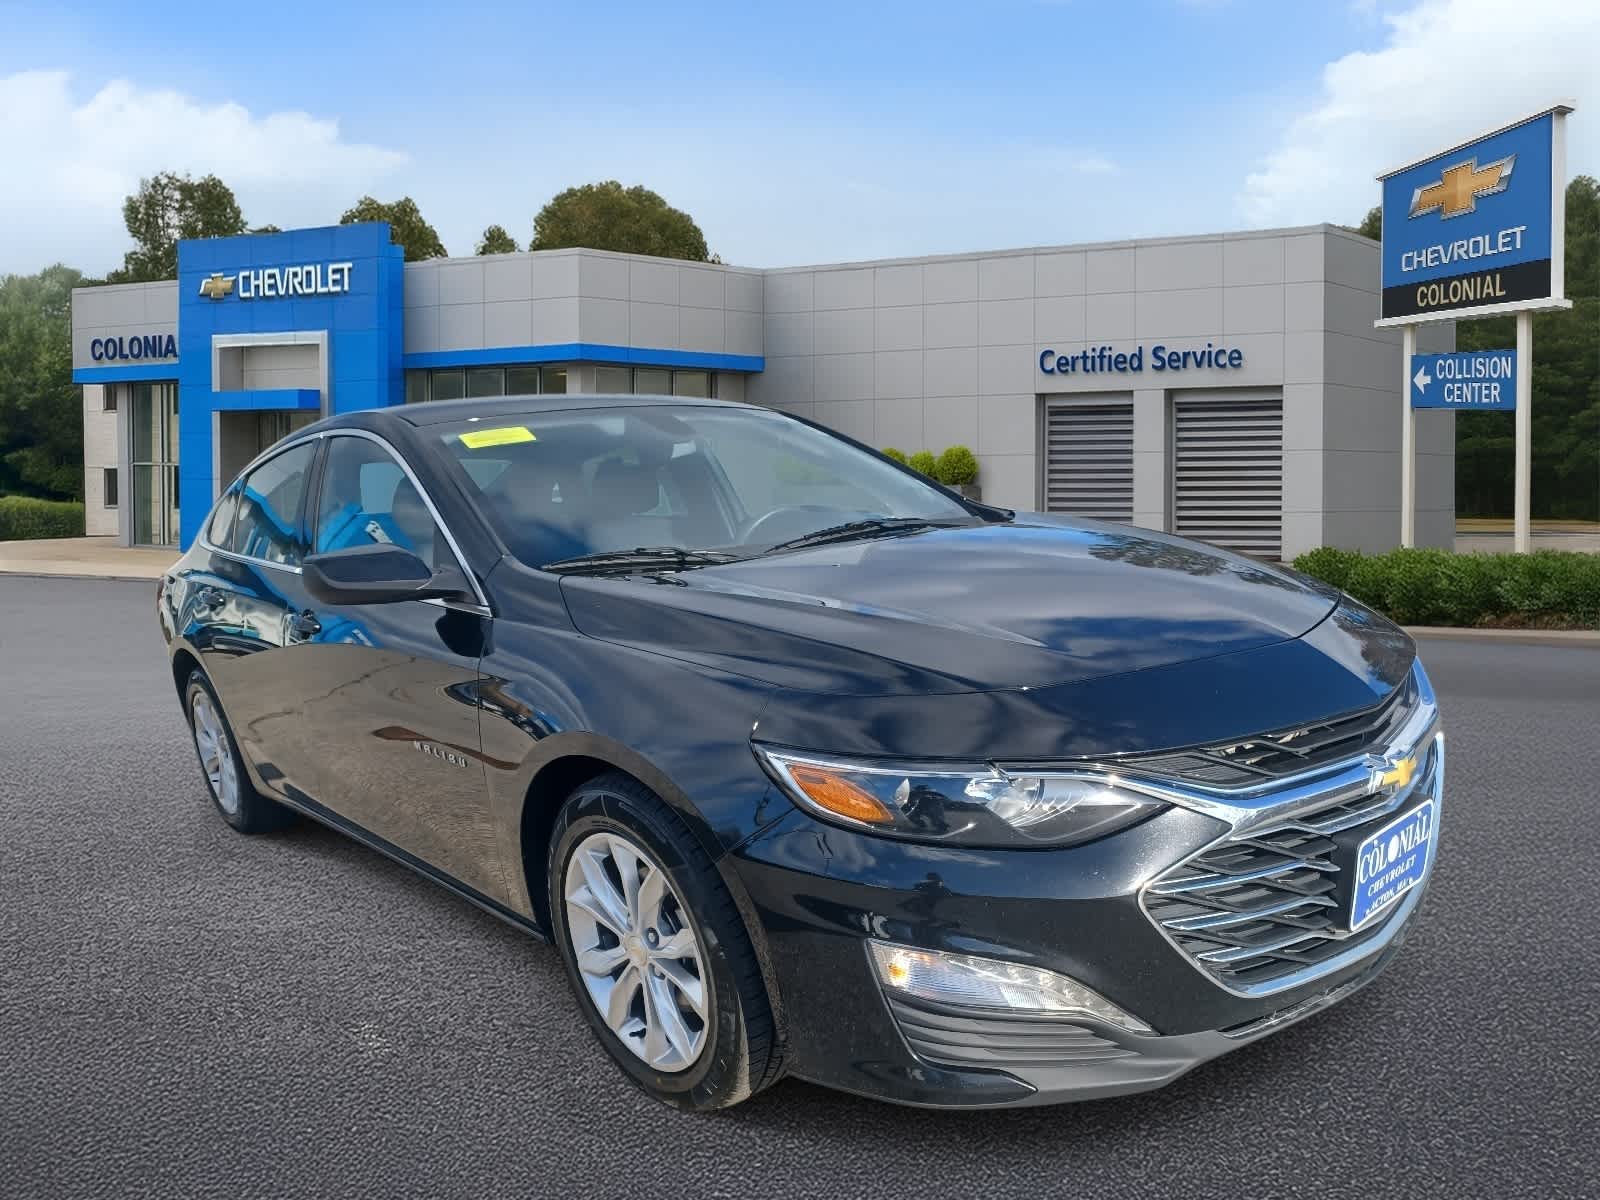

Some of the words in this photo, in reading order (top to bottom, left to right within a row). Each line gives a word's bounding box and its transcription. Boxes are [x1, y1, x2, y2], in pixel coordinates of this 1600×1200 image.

[1401, 225, 1527, 273] CHEVROLET
[238, 262, 353, 298] CHEVROLET
[1416, 273, 1506, 307] COLONIAL
[1039, 346, 1143, 375] Certified
[1151, 343, 1243, 371] Service
[1436, 356, 1512, 379] COLLISION
[1444, 382, 1501, 403] CENTER
[414, 740, 468, 768] MALIBU
[1367, 854, 1417, 897] CHEVROLET
